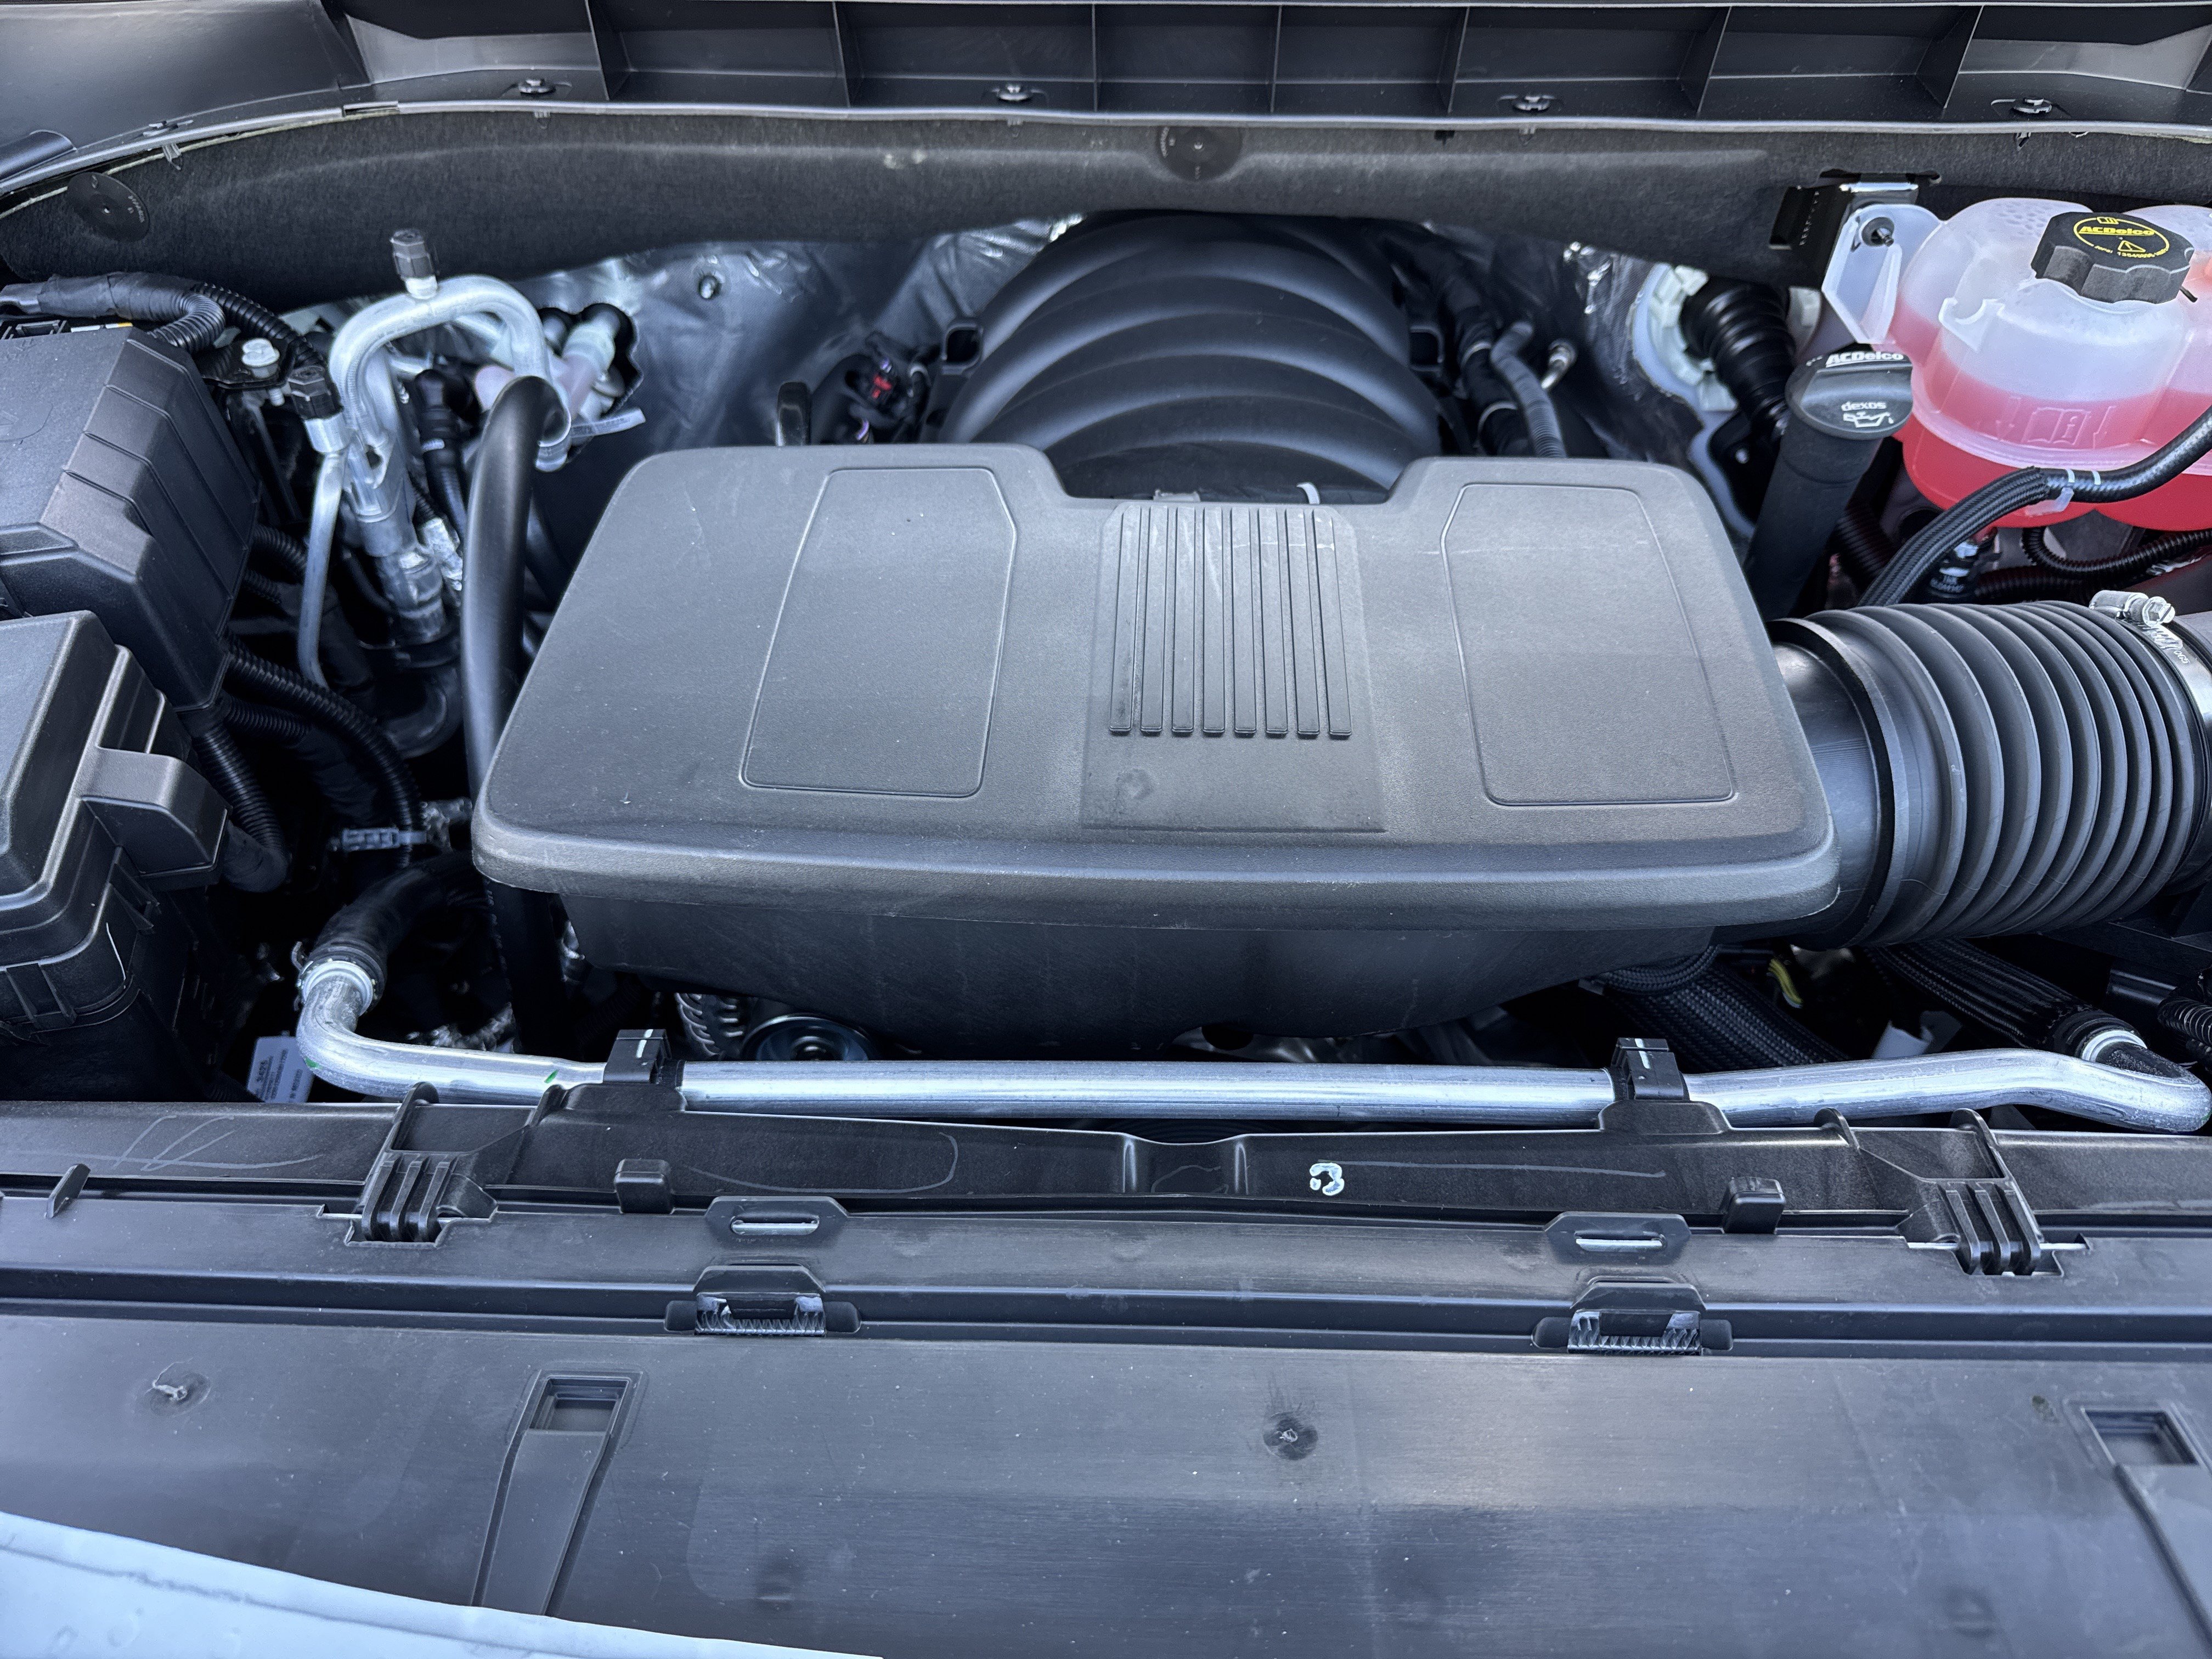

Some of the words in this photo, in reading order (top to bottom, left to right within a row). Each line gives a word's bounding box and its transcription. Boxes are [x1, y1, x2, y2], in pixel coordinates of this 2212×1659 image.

[2079, 226, 2155, 235] ACDelco
[1826, 351, 1904, 366] ACDelco
[1841, 401, 1886, 411] dexos
